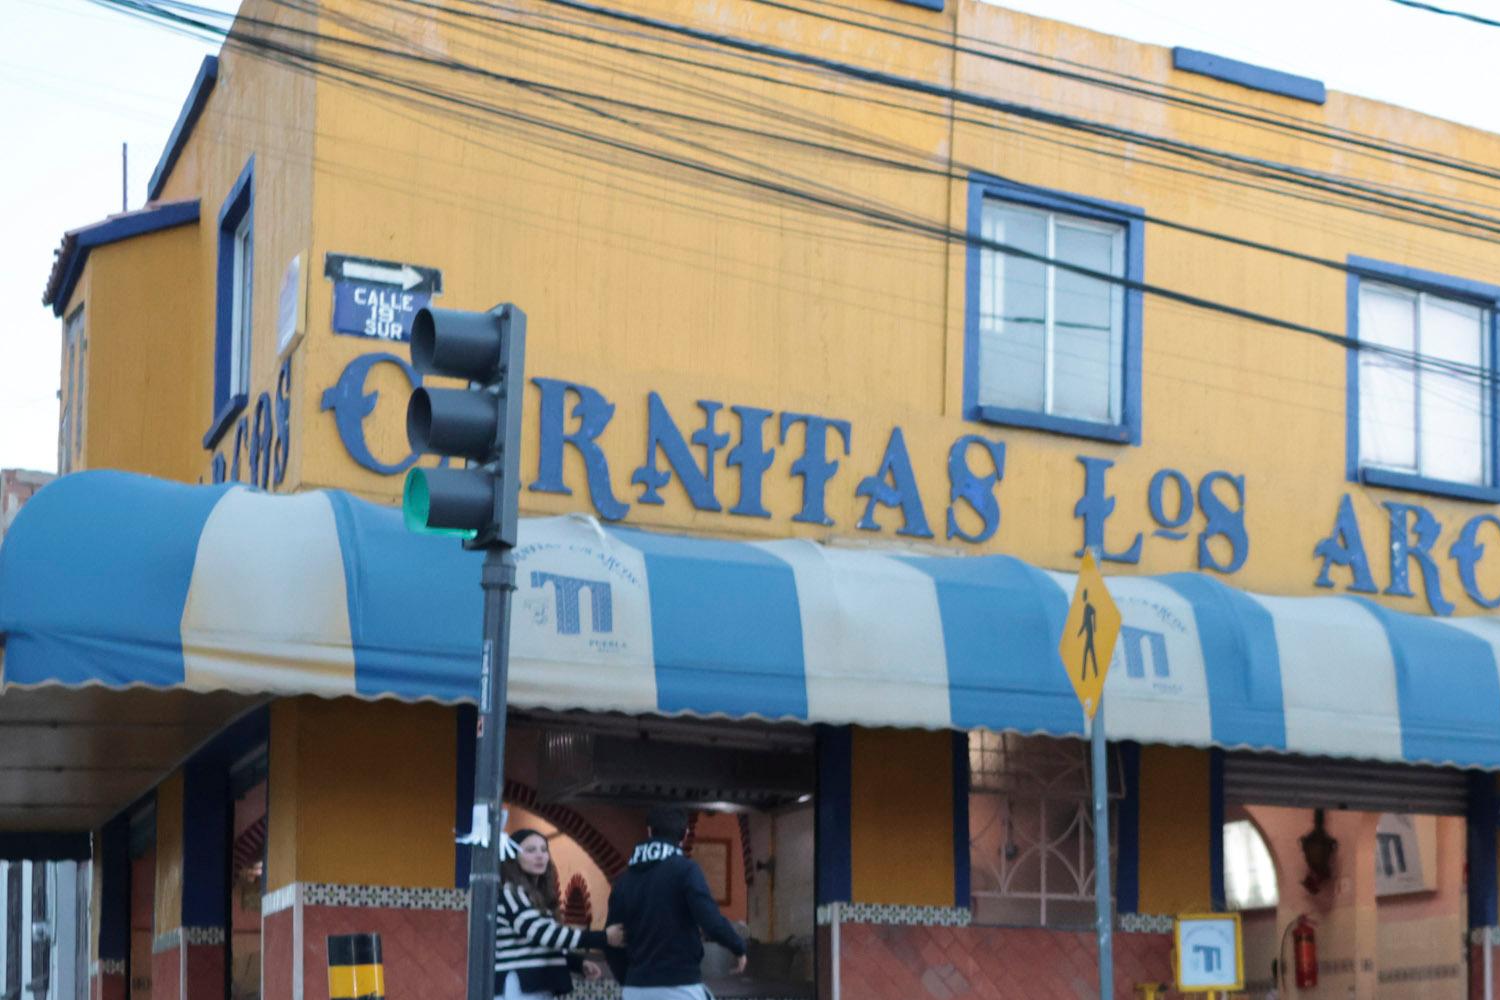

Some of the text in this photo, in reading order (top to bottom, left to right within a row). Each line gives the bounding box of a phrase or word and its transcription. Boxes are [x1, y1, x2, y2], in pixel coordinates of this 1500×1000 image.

[354, 287, 414, 312] CALLE
[364, 318, 403, 340] SUR
[320, 352, 1006, 543] CRNITAS
